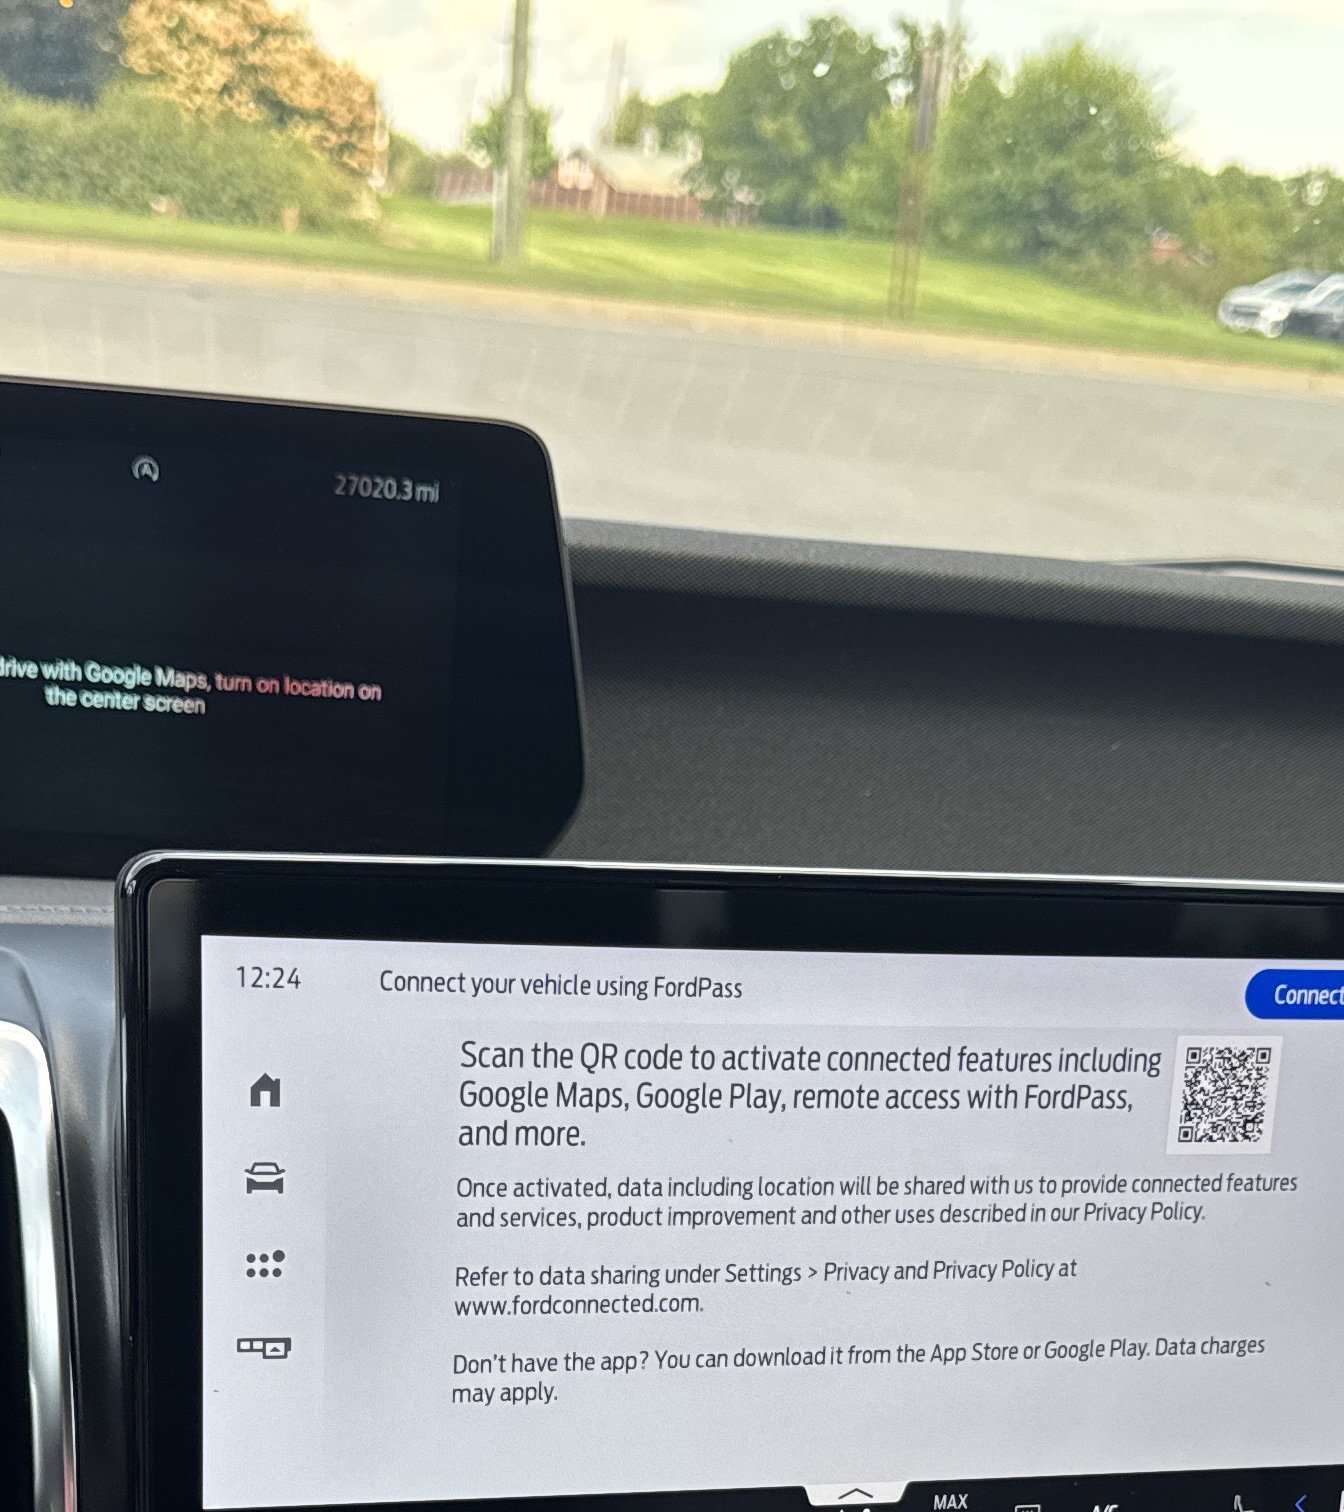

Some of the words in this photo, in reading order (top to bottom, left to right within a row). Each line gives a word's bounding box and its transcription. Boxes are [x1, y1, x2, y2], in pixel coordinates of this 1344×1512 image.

[335, 474, 413, 501] 27020.3
[415, 482, 440, 503] mi
[40, 658, 82, 682] with
[83, 659, 152, 690] Google
[154, 665, 211, 692] Maps,
[213, 671, 252, 692] turn
[256, 676, 280, 694] on
[284, 673, 354, 699] location
[358, 683, 382, 701] on
[44, 684, 77, 706] the
[78, 688, 140, 711] center
[142, 691, 205, 715] screen
[236, 965, 302, 990] 12:24
[380, 969, 467, 994] Connect
[470, 976, 517, 998] your
[520, 972, 592, 996] vehicle
[596, 975, 649, 1001] using
[653, 975, 743, 999] FordPass
[460, 1040, 524, 1069] Scan
[530, 1041, 574, 1070] the
[580, 1042, 618, 1075] QR
[624, 1042, 683, 1071] code
[689, 1044, 716, 1071] to
[721, 1044, 821, 1072] activate
[827, 1045, 952, 1073] connected
[957, 1045, 1053, 1073] features
[1058, 1046, 1163, 1079] including
[459, 1079, 549, 1114] Google
[556, 1081, 630, 1114] Maps,
[636, 1081, 723, 1115] Google
[729, 1082, 787, 1114] Play,
[793, 1084, 880, 1110] remote
[885, 1089, 961, 1110] access
[966, 1083, 1018, 1110] with
[1024, 1083, 1133, 1113] FordPass,
[458, 1119, 508, 1147] and
[515, 1125, 586, 1147] more.
[456, 1177, 508, 1198] Once
[513, 1176, 612, 1200] activated,
[617, 1176, 664, 1198] data
[667, 1175, 754, 1201] including
[758, 1175, 835, 1197] location
[839, 1175, 872, 1196] will
[876, 1175, 900, 1196] be
[903, 1174, 966, 1196] shared
[969, 1174, 1010, 1195] with
[1013, 1179, 1034, 1195] us
[1038, 1175, 1058, 1195] to
[1060, 1173, 1128, 1198] provide
[1131, 1172, 1224, 1194] connected
[1225, 1172, 1298, 1193] features
[456, 1206, 495, 1228] and
[499, 1206, 582, 1230] services,
[586, 1205, 664, 1231] product
[667, 1204, 797, 1230] improvement
[800, 1204, 838, 1225] and
[841, 1203, 892, 1225] other
[895, 1208, 935, 1224] uses
[939, 1202, 1028, 1224] described
[1030, 1203, 1047, 1223] in
[1050, 1206, 1081, 1222] our
[1083, 1202, 1148, 1225] Privacy
[1150, 1200, 1206, 1225] Policy.
[455, 1265, 509, 1287] Refer
[512, 1266, 534, 1286] to
[539, 1264, 586, 1286] data
[590, 1264, 661, 1288] sharing
[665, 1263, 721, 1284] under
[724, 1262, 802, 1286] Settings
[823, 1261, 891, 1285] Privacy
[893, 1259, 929, 1281] and
[932, 1259, 998, 1283] Privacy
[1001, 1258, 1056, 1282] Policy
[1058, 1258, 1078, 1278] at
[454, 1292, 704, 1317] www.fordconnected.com.
[511, 1352, 558, 1373] have
[563, 1351, 596, 1372] the
[600, 1350, 649, 1375] app?
[654, 1349, 691, 1370] You
[695, 1353, 729, 1369] can
[733, 1345, 827, 1368] download
[830, 1345, 844, 1366] it
[847, 1344, 891, 1365] from
[896, 1343, 926, 1364] the
[929, 1343, 967, 1366] App
[970, 1342, 1019, 1362] Store
[1022, 1344, 1042, 1360] or
[1044, 1338, 1106, 1362] Google
[1109, 1337, 1151, 1361] Play.
[1154, 1337, 1196, 1357] Data
[1200, 1335, 1266, 1358] charges
[452, 1386, 496, 1407] may
[499, 1380, 558, 1406] apply.
[933, 1493, 969, 1511] MAX
